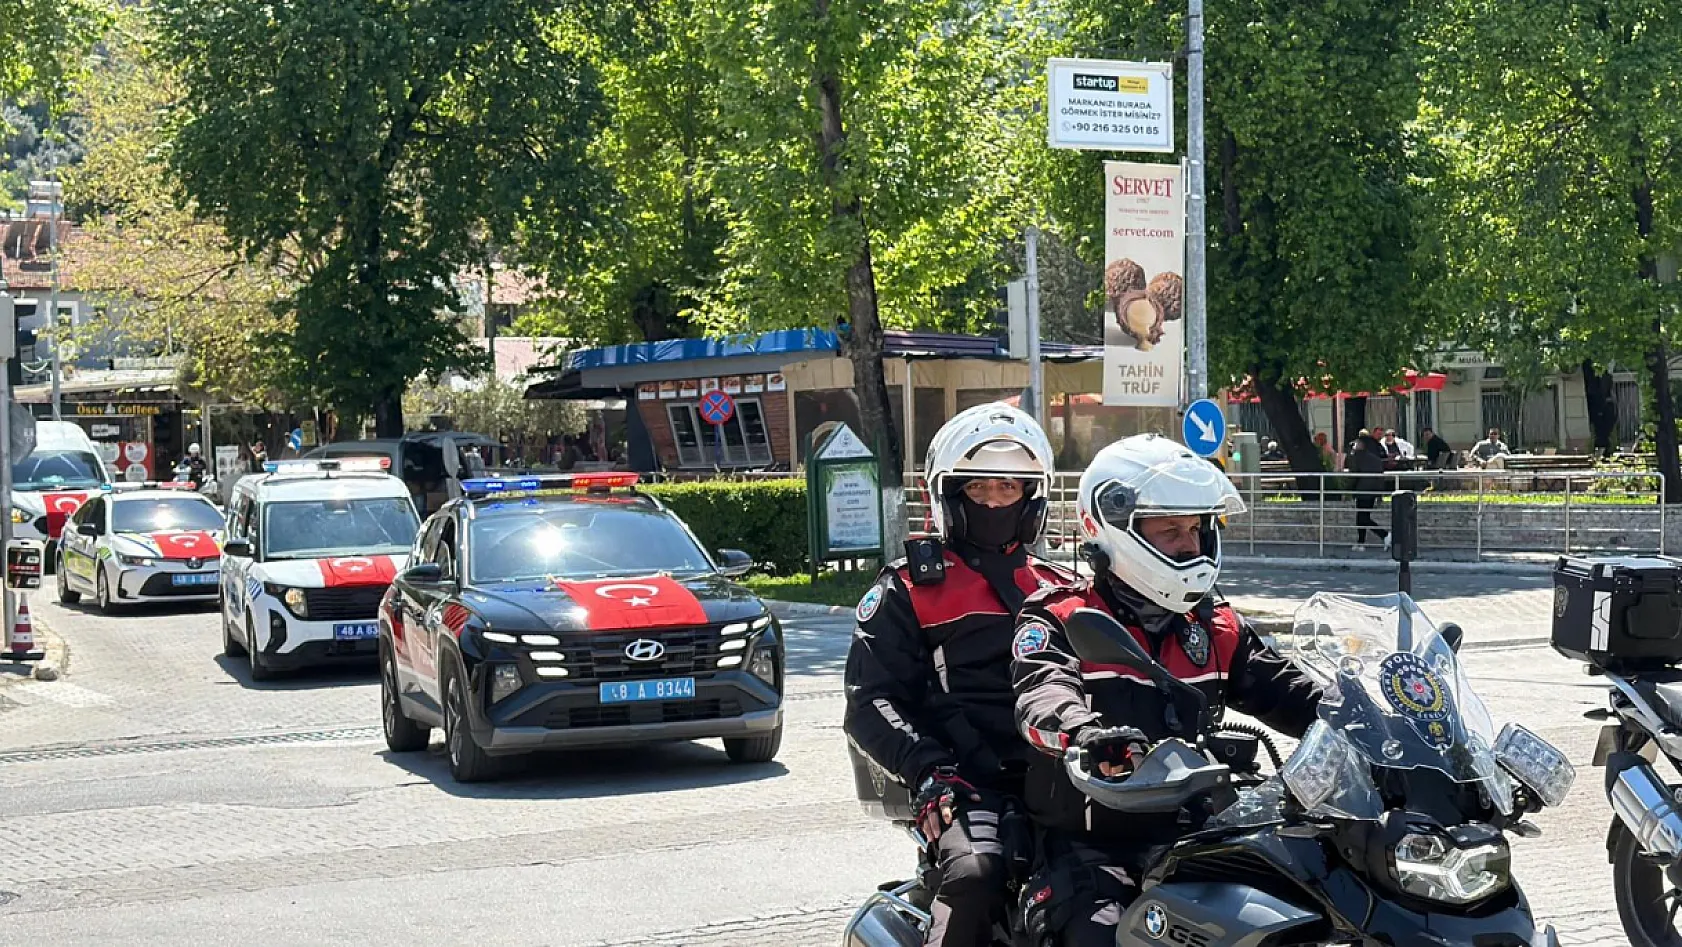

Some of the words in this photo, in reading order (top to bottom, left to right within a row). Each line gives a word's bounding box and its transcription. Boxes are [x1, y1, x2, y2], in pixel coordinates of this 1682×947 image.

[1075, 76, 1117, 90] startup
[1068, 98, 1116, 107] MARKANIZI
[1117, 100, 1152, 109] BURADA
[1061, 107, 1098, 117] GÖRMEK
[1100, 108, 1123, 118] İSTER
[1072, 122, 1090, 132] +90
[1092, 124, 1110, 133] 216
[1112, 124, 1131, 134] 325
[1133, 125, 1144, 134] 01
[1112, 226, 1175, 238] servet.com
[1118, 361, 1164, 378] TAHİN
[1121, 378, 1161, 395] TRÜF
[340, 624, 354, 636] 48
[356, 624, 364, 636] A
[637, 682, 646, 699] A
[656, 679, 692, 698] 8344
